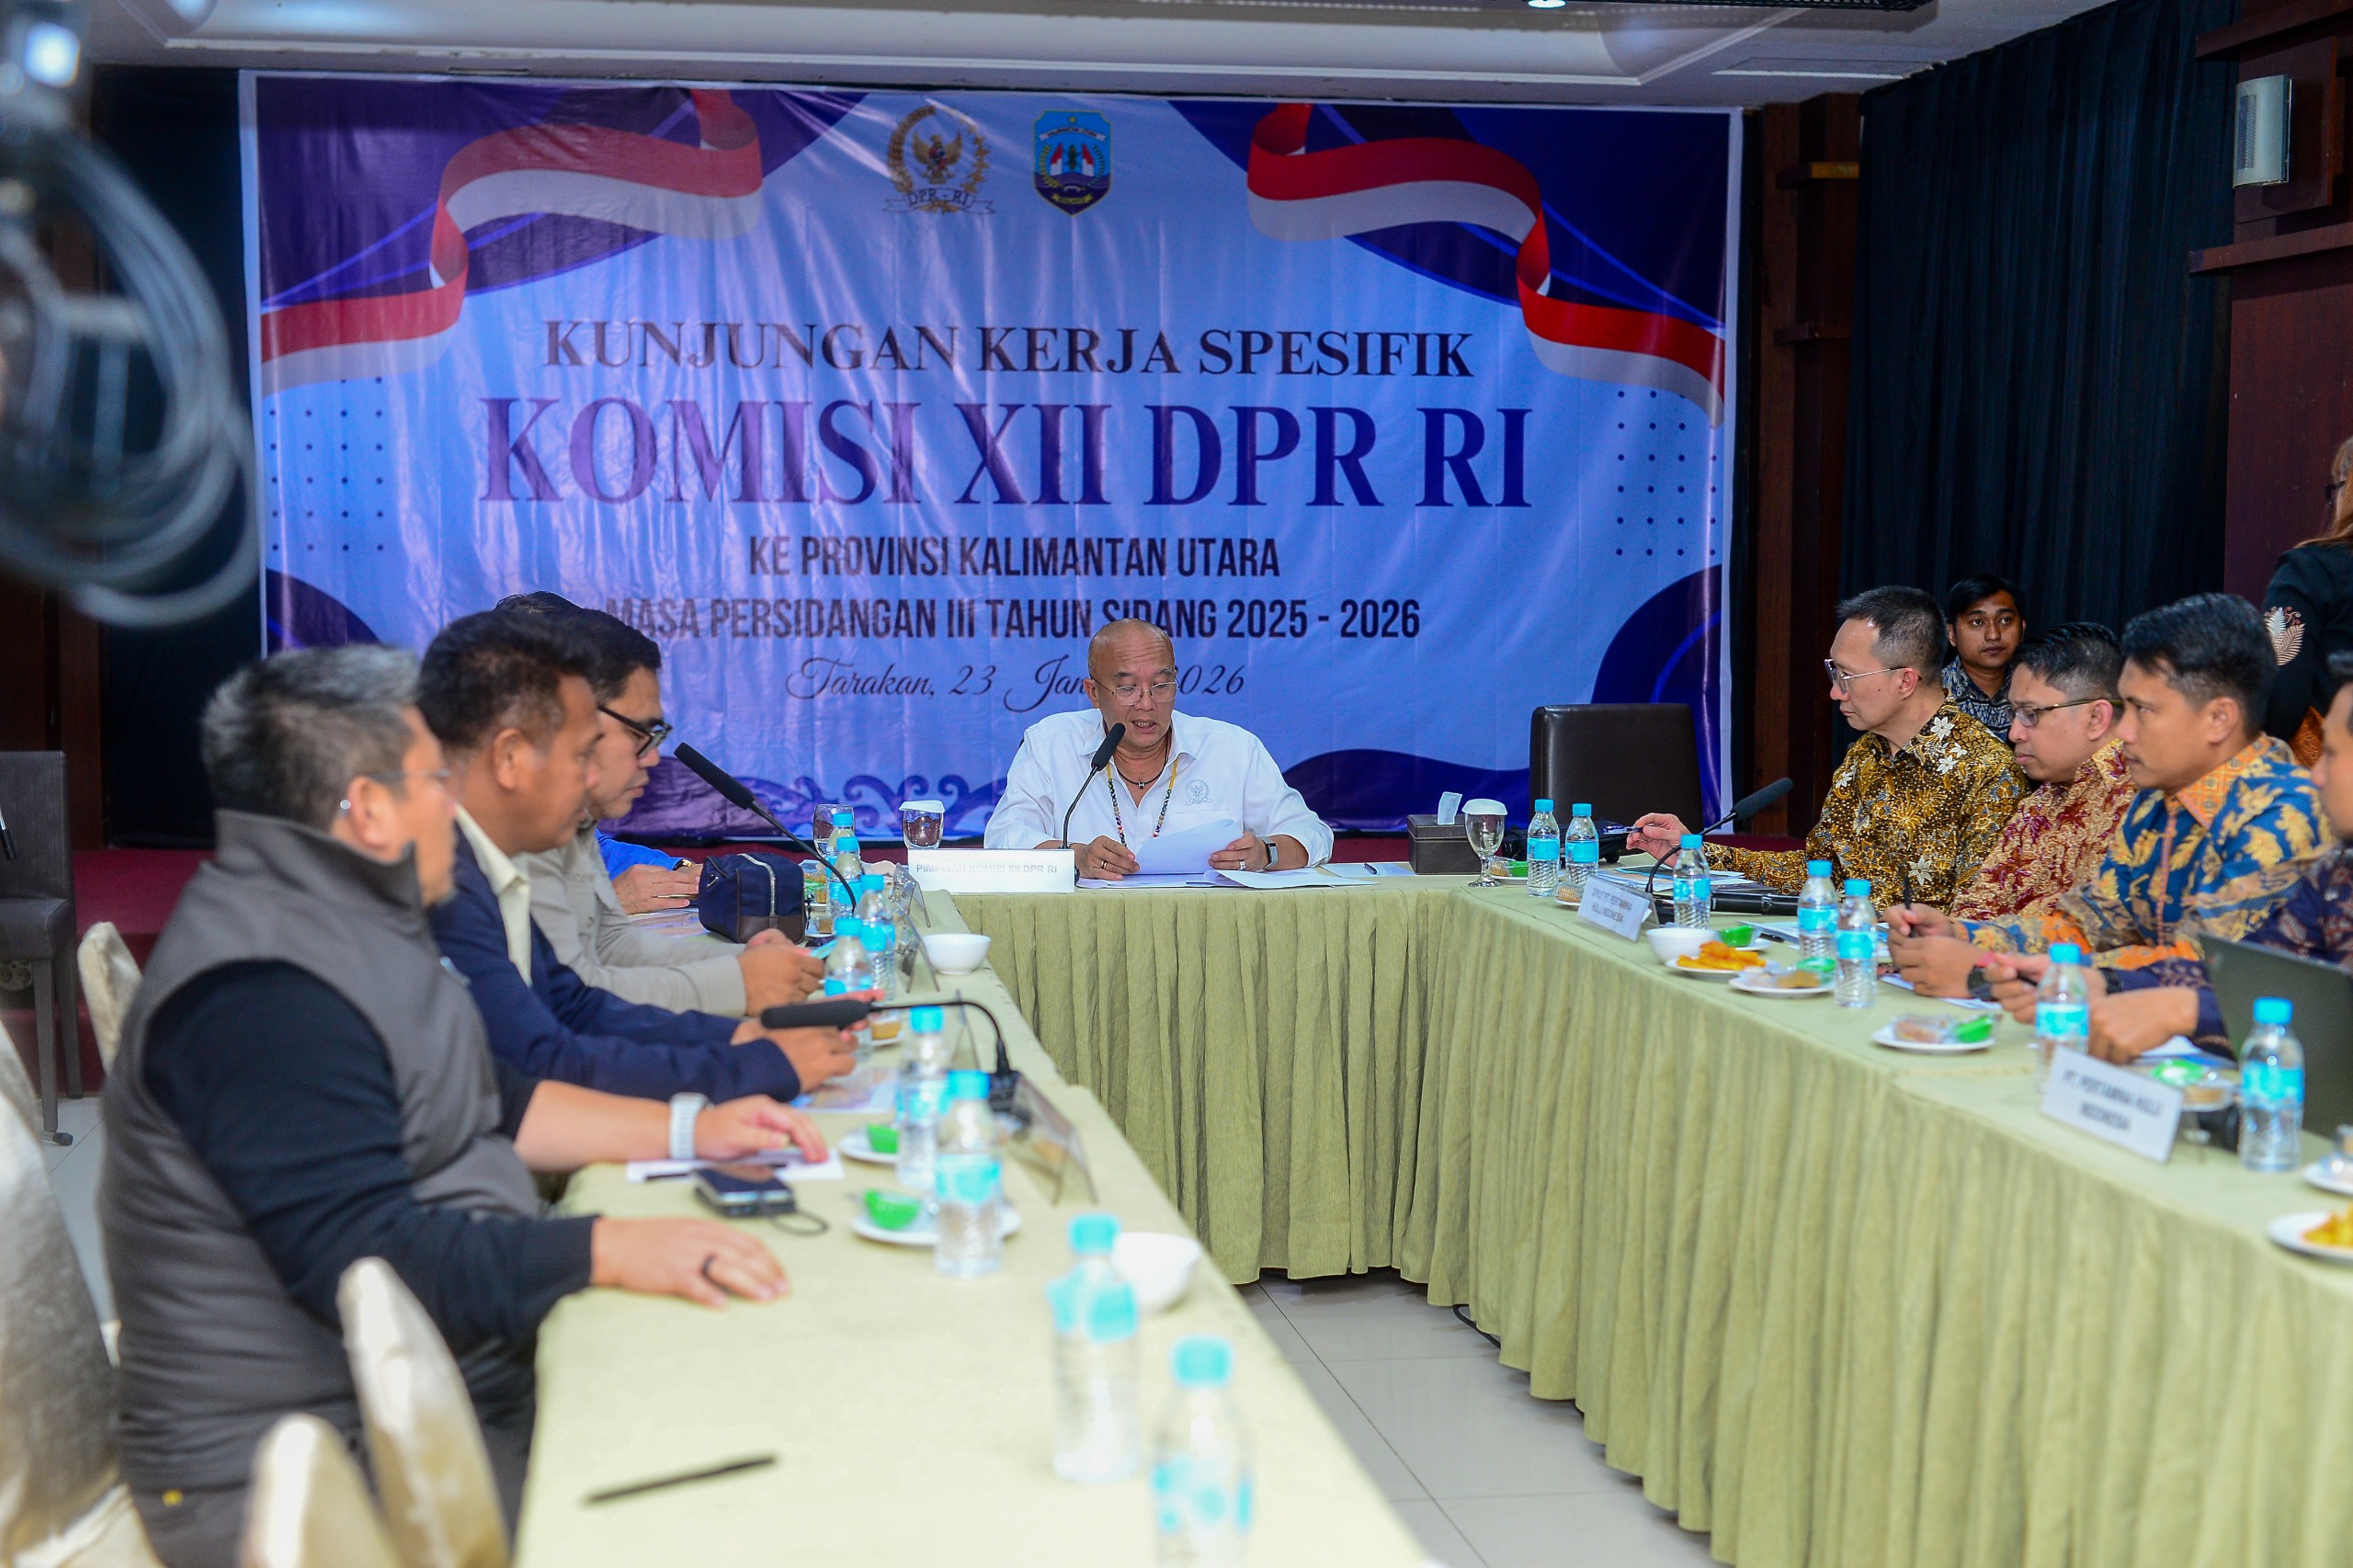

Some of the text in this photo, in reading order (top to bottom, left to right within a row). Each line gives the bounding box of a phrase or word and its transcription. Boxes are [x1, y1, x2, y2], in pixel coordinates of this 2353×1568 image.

[544, 320, 1474, 379] KUNJUNGAN KERJA SPESIFIK
[479, 396, 1534, 508] KOMISI XII DPR RI
[749, 536, 1280, 577] KE PROVINSI KALIMANTAN UTARA
[605, 597, 699, 639] MASA
[710, 598, 937, 639] PERSIDANGAN
[948, 599, 975, 638] III
[989, 599, 1092, 639] TAHUN
[1227, 599, 1308, 639] 2025
[1318, 615, 1330, 623] -
[1340, 599, 1421, 639] 2026
[785, 656, 936, 700] Tarakan,
[949, 665, 997, 695] 23
[1175, 665, 1245, 696] 026
[1007, 865, 1020, 874] XII
[1023, 865, 1045, 874] DPR
[1047, 865, 1058, 874] RI
